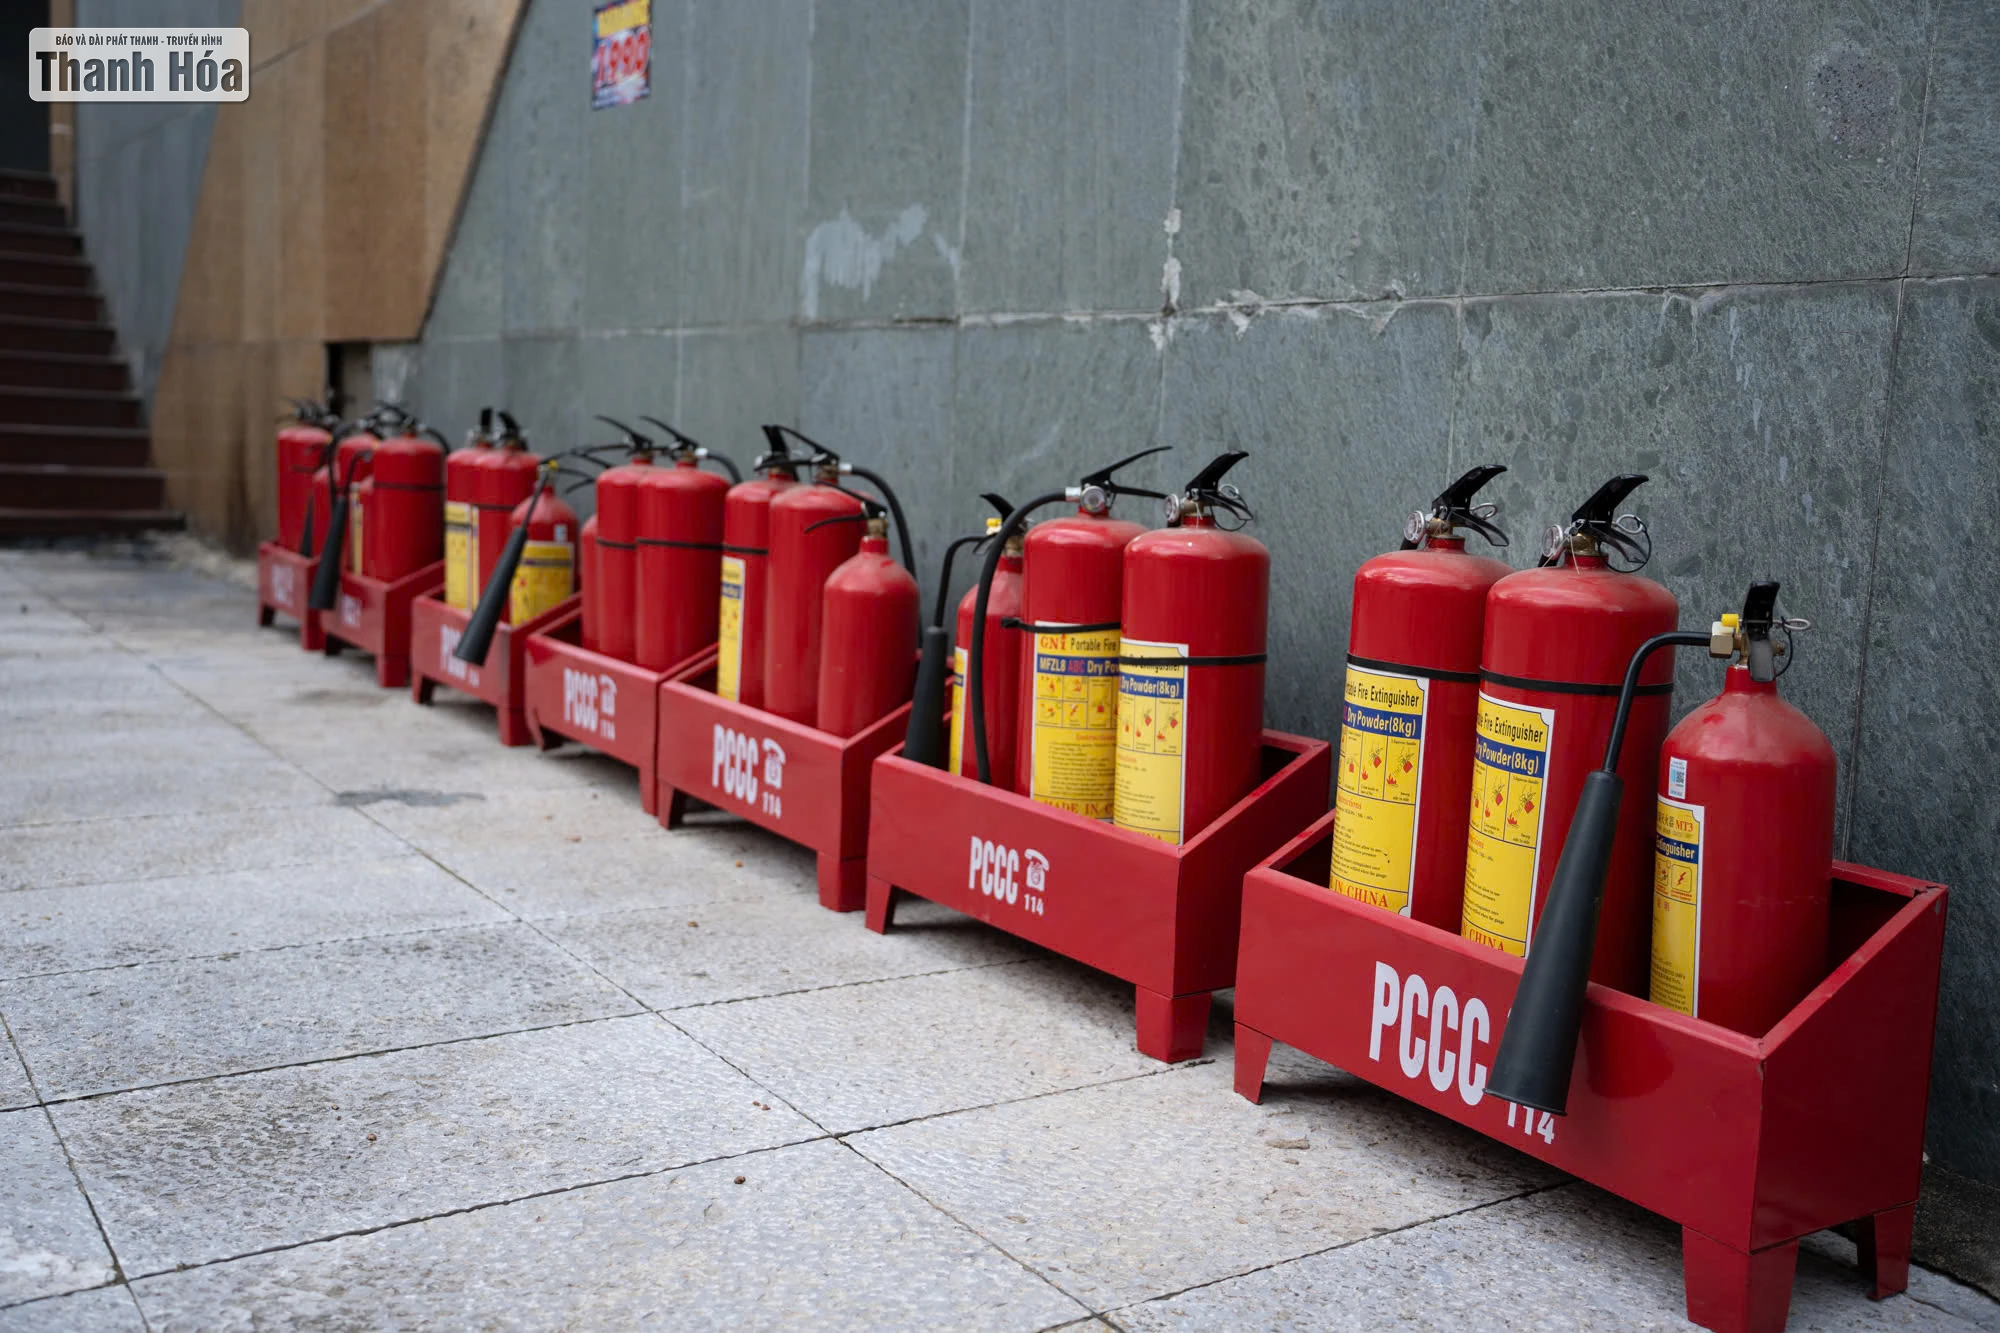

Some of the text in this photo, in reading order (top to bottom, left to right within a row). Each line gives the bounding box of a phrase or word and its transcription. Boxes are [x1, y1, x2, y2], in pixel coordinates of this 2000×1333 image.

[1070, 637, 1101, 651] Portable
[1103, 638, 1117, 651] Fire
[1040, 656, 1066, 673] MFZL8
[1087, 660, 1103, 676] Dry
[1130, 677, 1180, 698] Powder(8kg)
[1358, 682, 1369, 700] Fire
[1370, 685, 1420, 708] Extinguisher
[1347, 707, 1417, 737] Dry Powder(8kg)
[1484, 713, 1493, 732] Fire
[1494, 716, 1544, 743] Extinguisher
[712, 723, 759, 805] PCCC
[1482, 742, 1540, 775] Powder(8kg)
[762, 791, 782, 819] 114
[1084, 803, 1099, 815] IN
[1676, 819, 1695, 833] MT3
[968, 836, 1019, 905] PCCC
[1024, 893, 1045, 916] 114
[1347, 885, 1389, 908] CHINA
[1369, 961, 1490, 1106] PCCC
